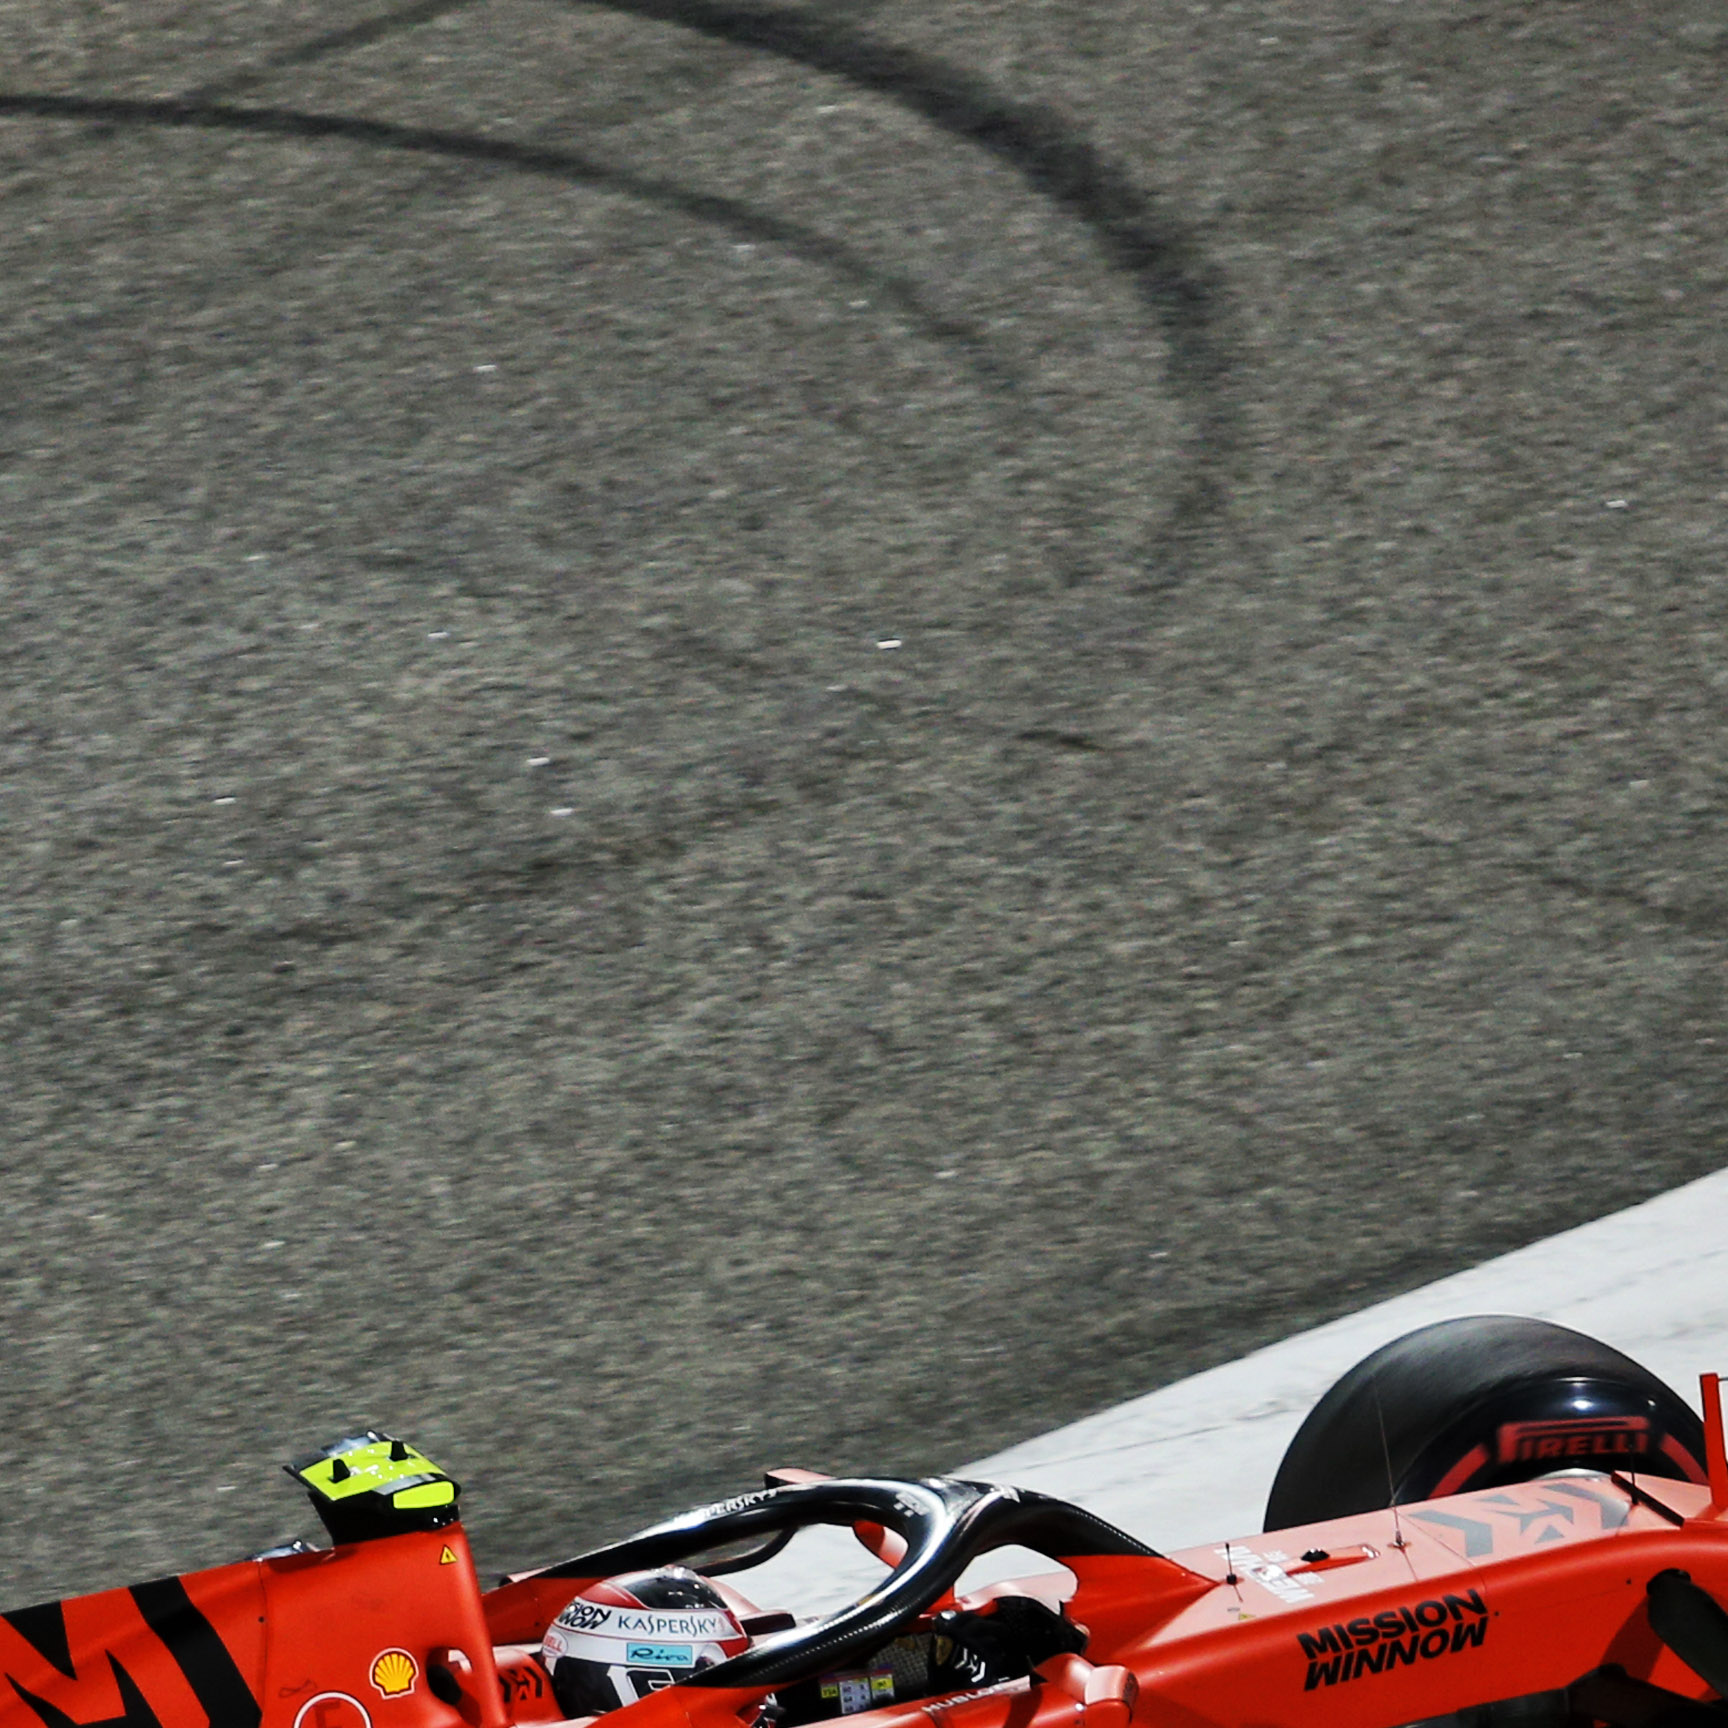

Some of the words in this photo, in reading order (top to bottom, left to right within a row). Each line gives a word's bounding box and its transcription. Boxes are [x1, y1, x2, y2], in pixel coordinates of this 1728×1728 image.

[1497, 1416, 1650, 1464] PIRELLI
[618, 1614, 716, 1637] KASPERSKY
[1297, 1589, 1488, 1659] MISSION
[1303, 1616, 1490, 1691] WINNOW
